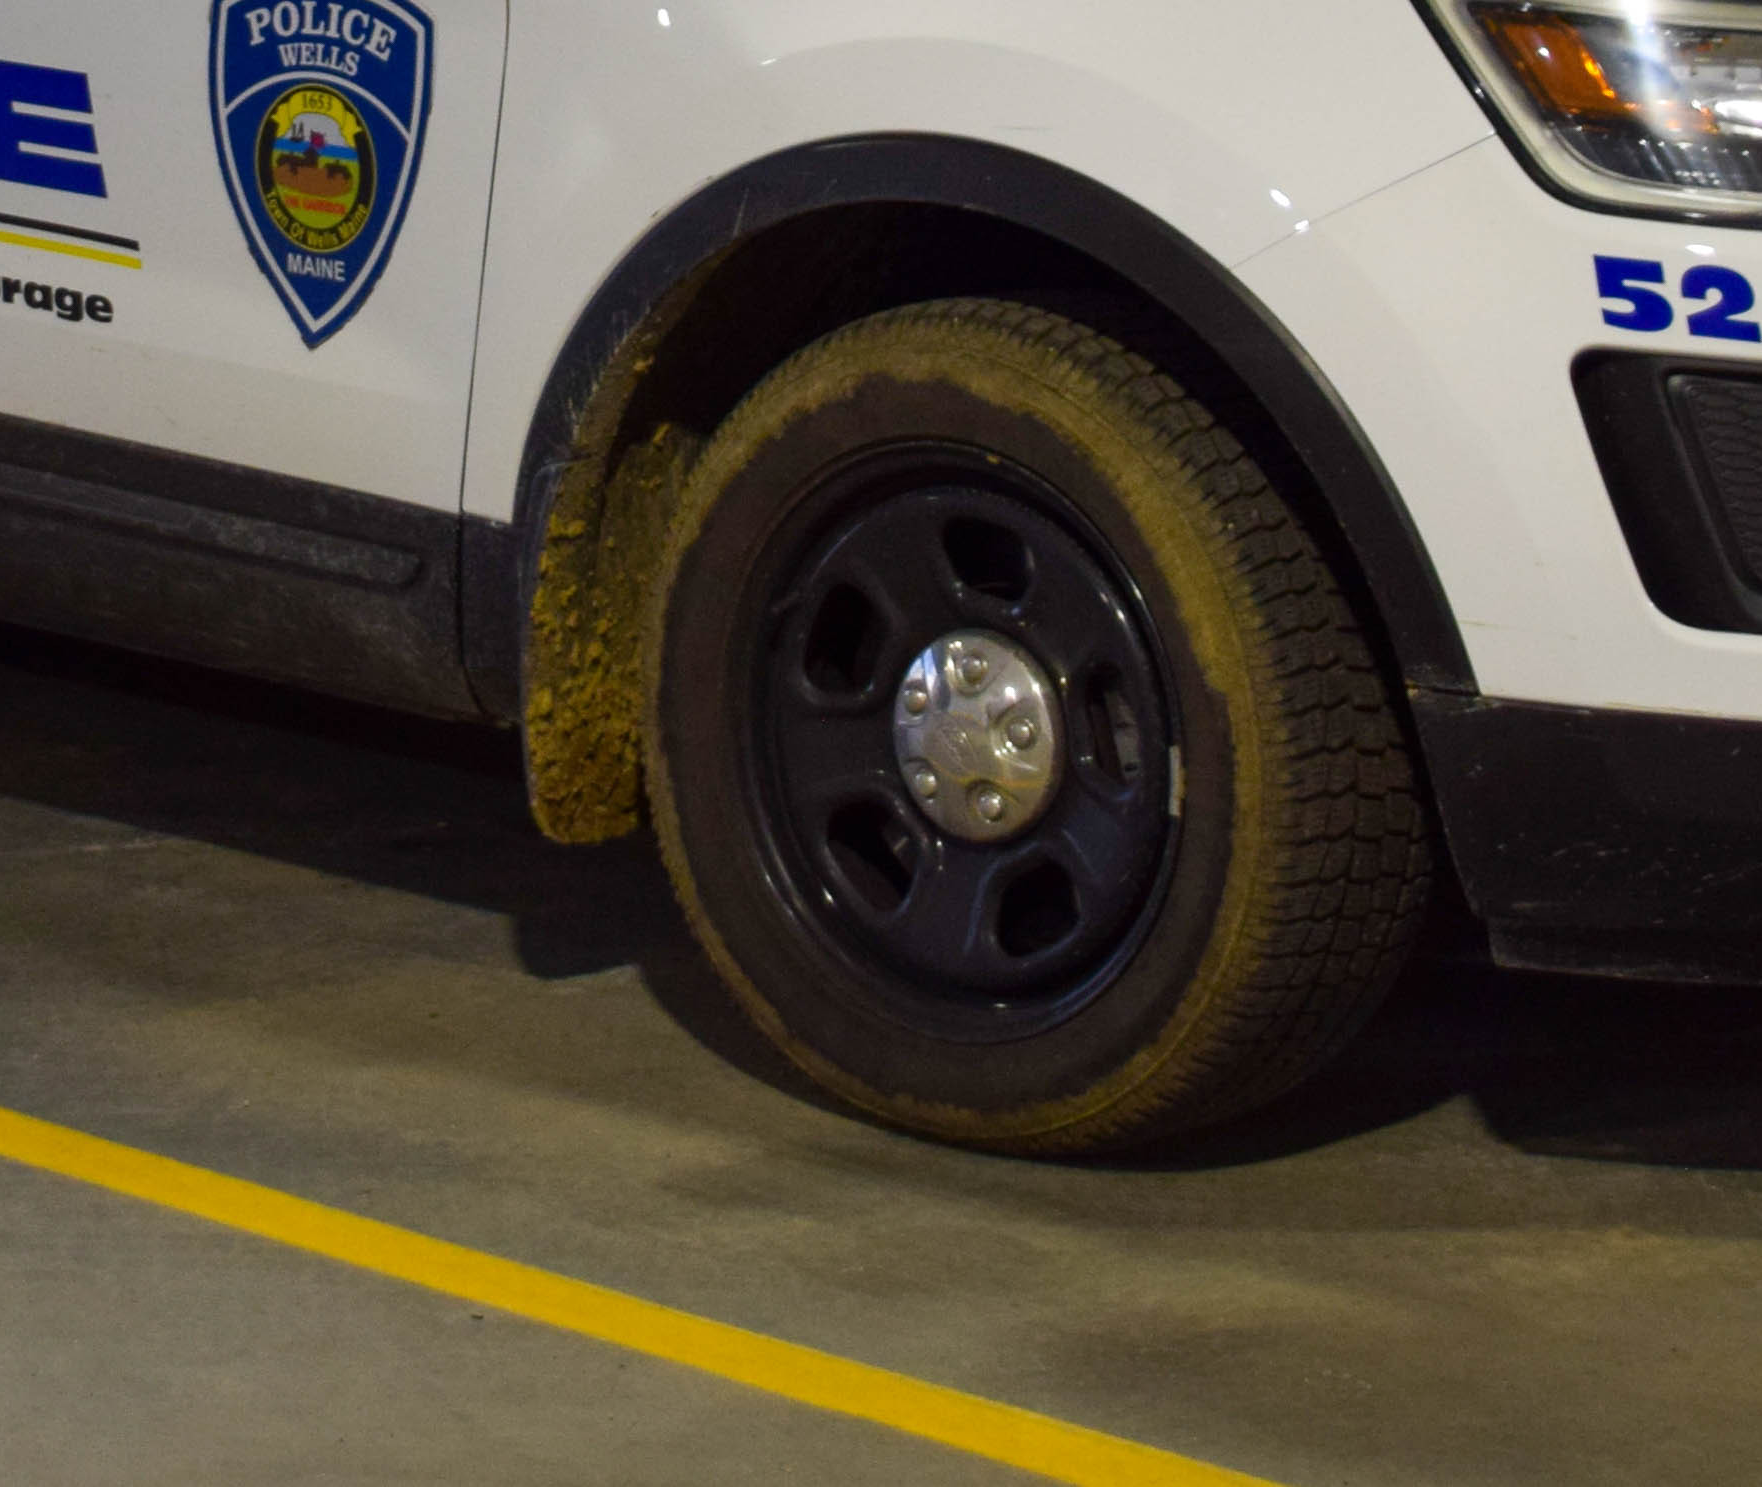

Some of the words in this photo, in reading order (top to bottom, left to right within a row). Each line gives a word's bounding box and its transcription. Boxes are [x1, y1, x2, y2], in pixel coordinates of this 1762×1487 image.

[245, 0, 397, 62] POLICE
[278, 42, 360, 77] WELLS
[302, 93, 333, 111] 1653
[287, 253, 345, 282] MAINE
[1593, 254, 1762, 343] 52
